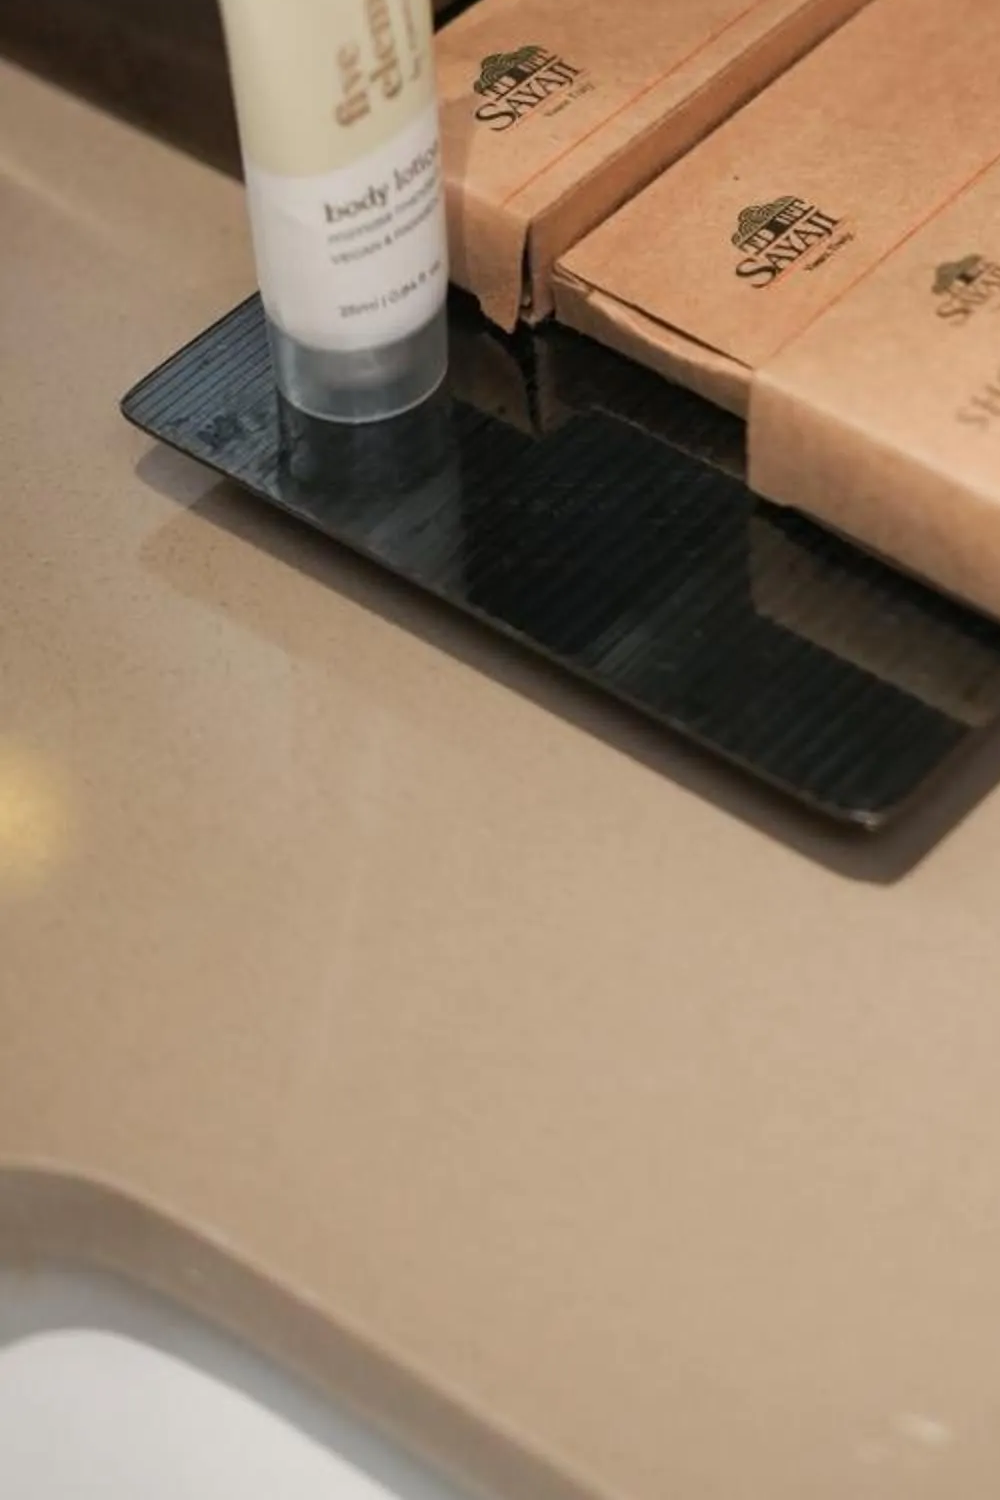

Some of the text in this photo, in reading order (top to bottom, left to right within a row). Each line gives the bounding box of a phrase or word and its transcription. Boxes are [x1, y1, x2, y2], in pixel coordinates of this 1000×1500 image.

[475, 59, 580, 131] SAYAJI
[324, 182, 389, 224] body
[736, 211, 839, 288] SAYAJI
